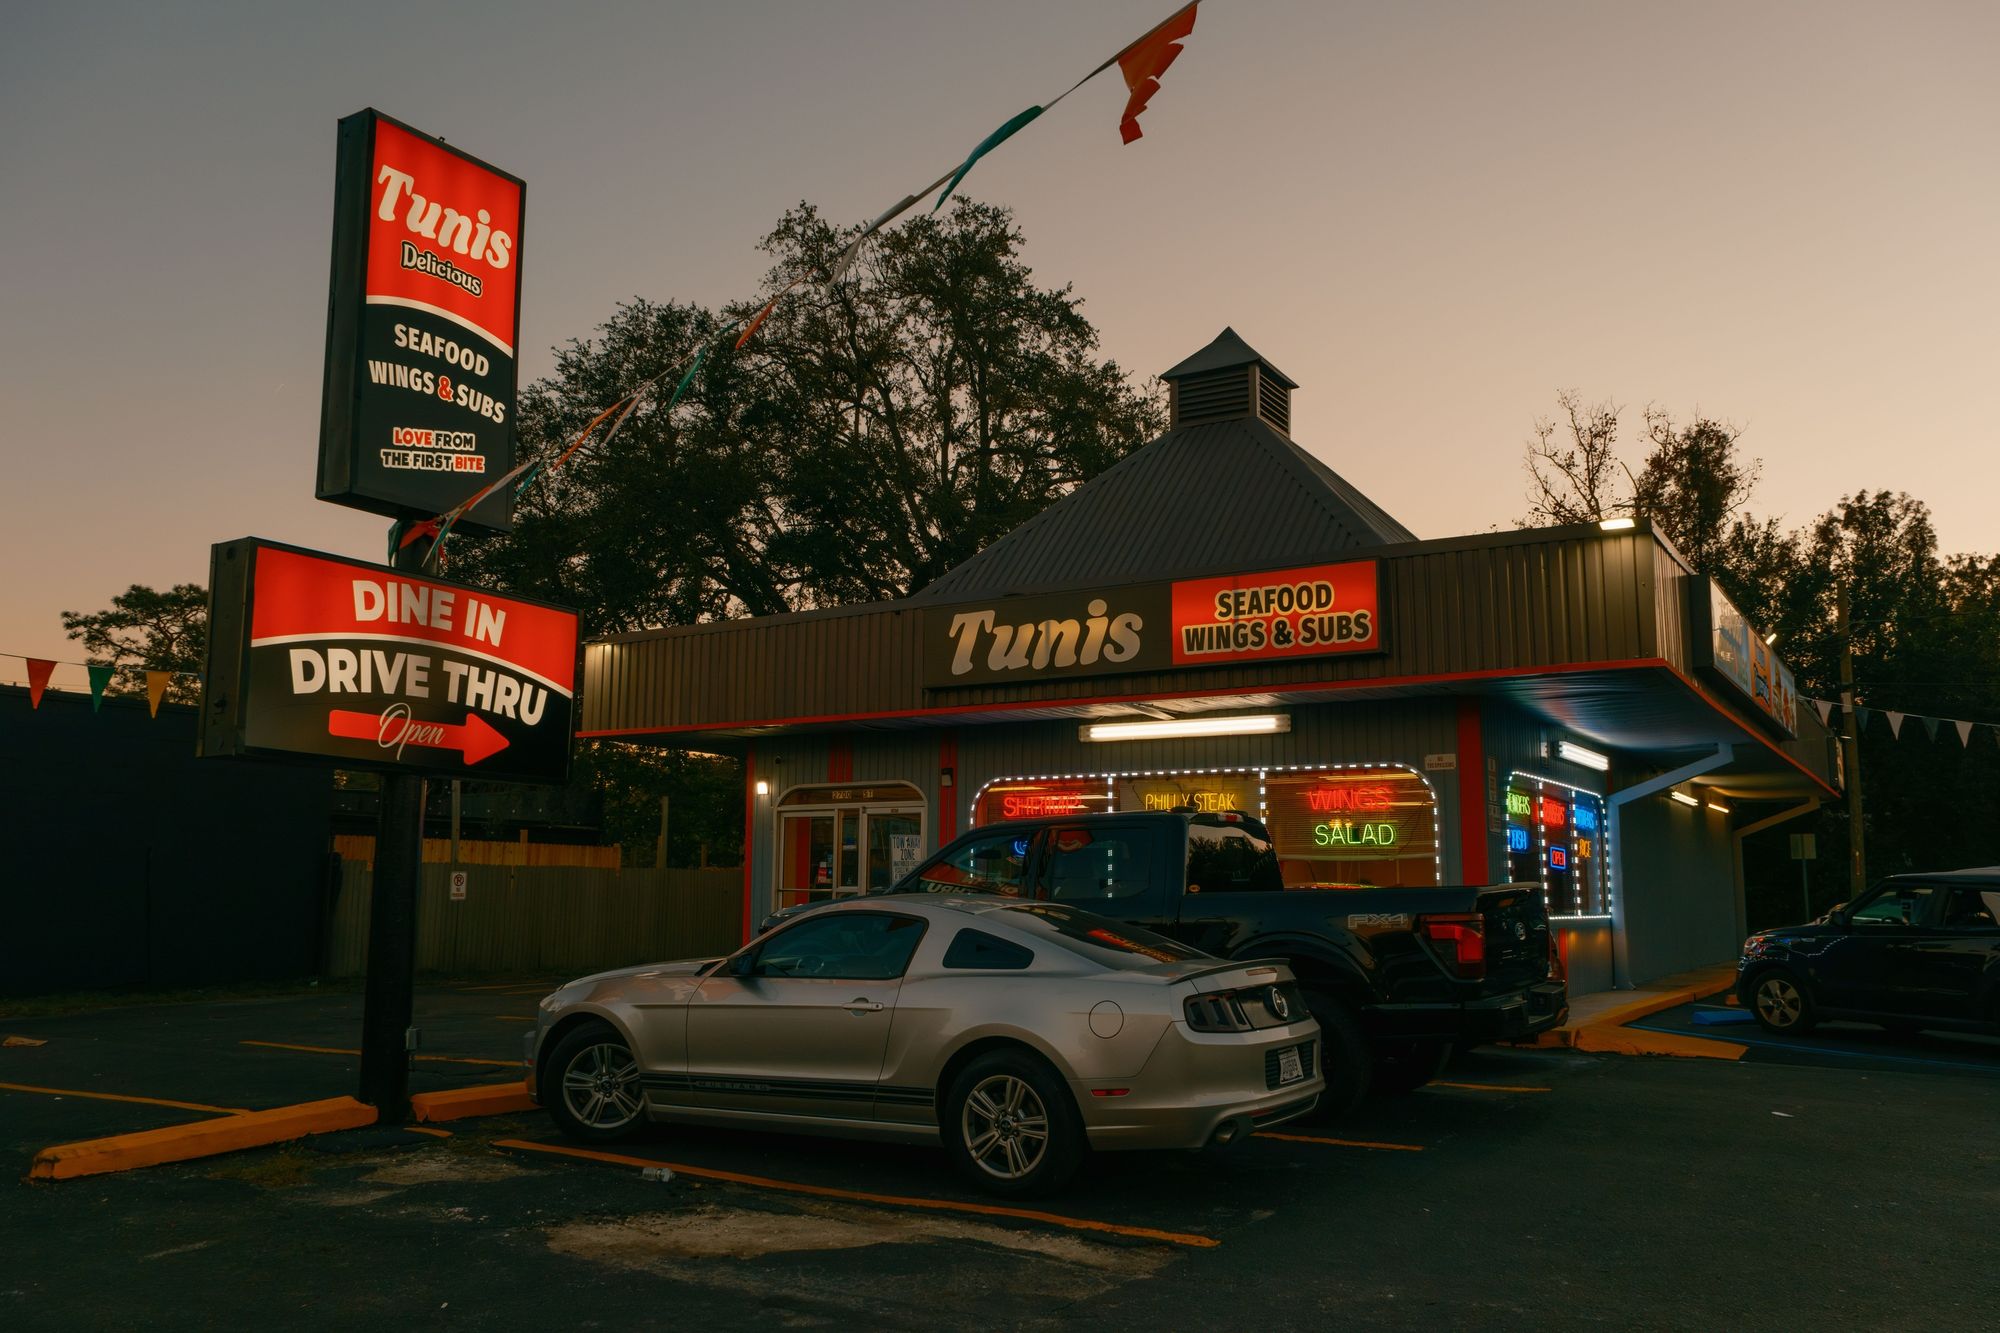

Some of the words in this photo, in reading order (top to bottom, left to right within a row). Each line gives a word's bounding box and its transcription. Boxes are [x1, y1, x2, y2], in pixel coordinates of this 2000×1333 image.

[378, 164, 513, 269] Tunis
[401, 241, 483, 297] Delicious
[394, 323, 489, 377] SEAFOOD
[368, 359, 435, 396] WINGS
[438, 375, 454, 403] &
[456, 383, 506, 424] SUBS
[394, 427, 432, 447] LOVE
[435, 429, 474, 450] FROM
[381, 449, 411, 469] THE
[412, 451, 453, 470] FIRST
[455, 455, 485, 472] BITE
[352, 579, 455, 632] DINE
[464, 599, 506, 648] IN
[1217, 582, 1333, 619] SEAFOOD
[948, 598, 1143, 676] Tunis
[1184, 622, 1265, 653] WINGS
[1273, 620, 1293, 645] &
[1300, 612, 1371, 643] SUBS
[289, 648, 430, 698] DRIVE
[443, 659, 548, 726] THRU
[378, 702, 446, 760] Open
[1003, 793, 1082, 817] SHRIMP
[1145, 793, 1190, 811] PHILLY
[1194, 792, 1236, 812] STEAK
[1308, 787, 1392, 811] WINGS
[1315, 823, 1395, 846] SALAD
[900, 848, 916, 861] ZONE
[1348, 913, 1408, 929] FX4
